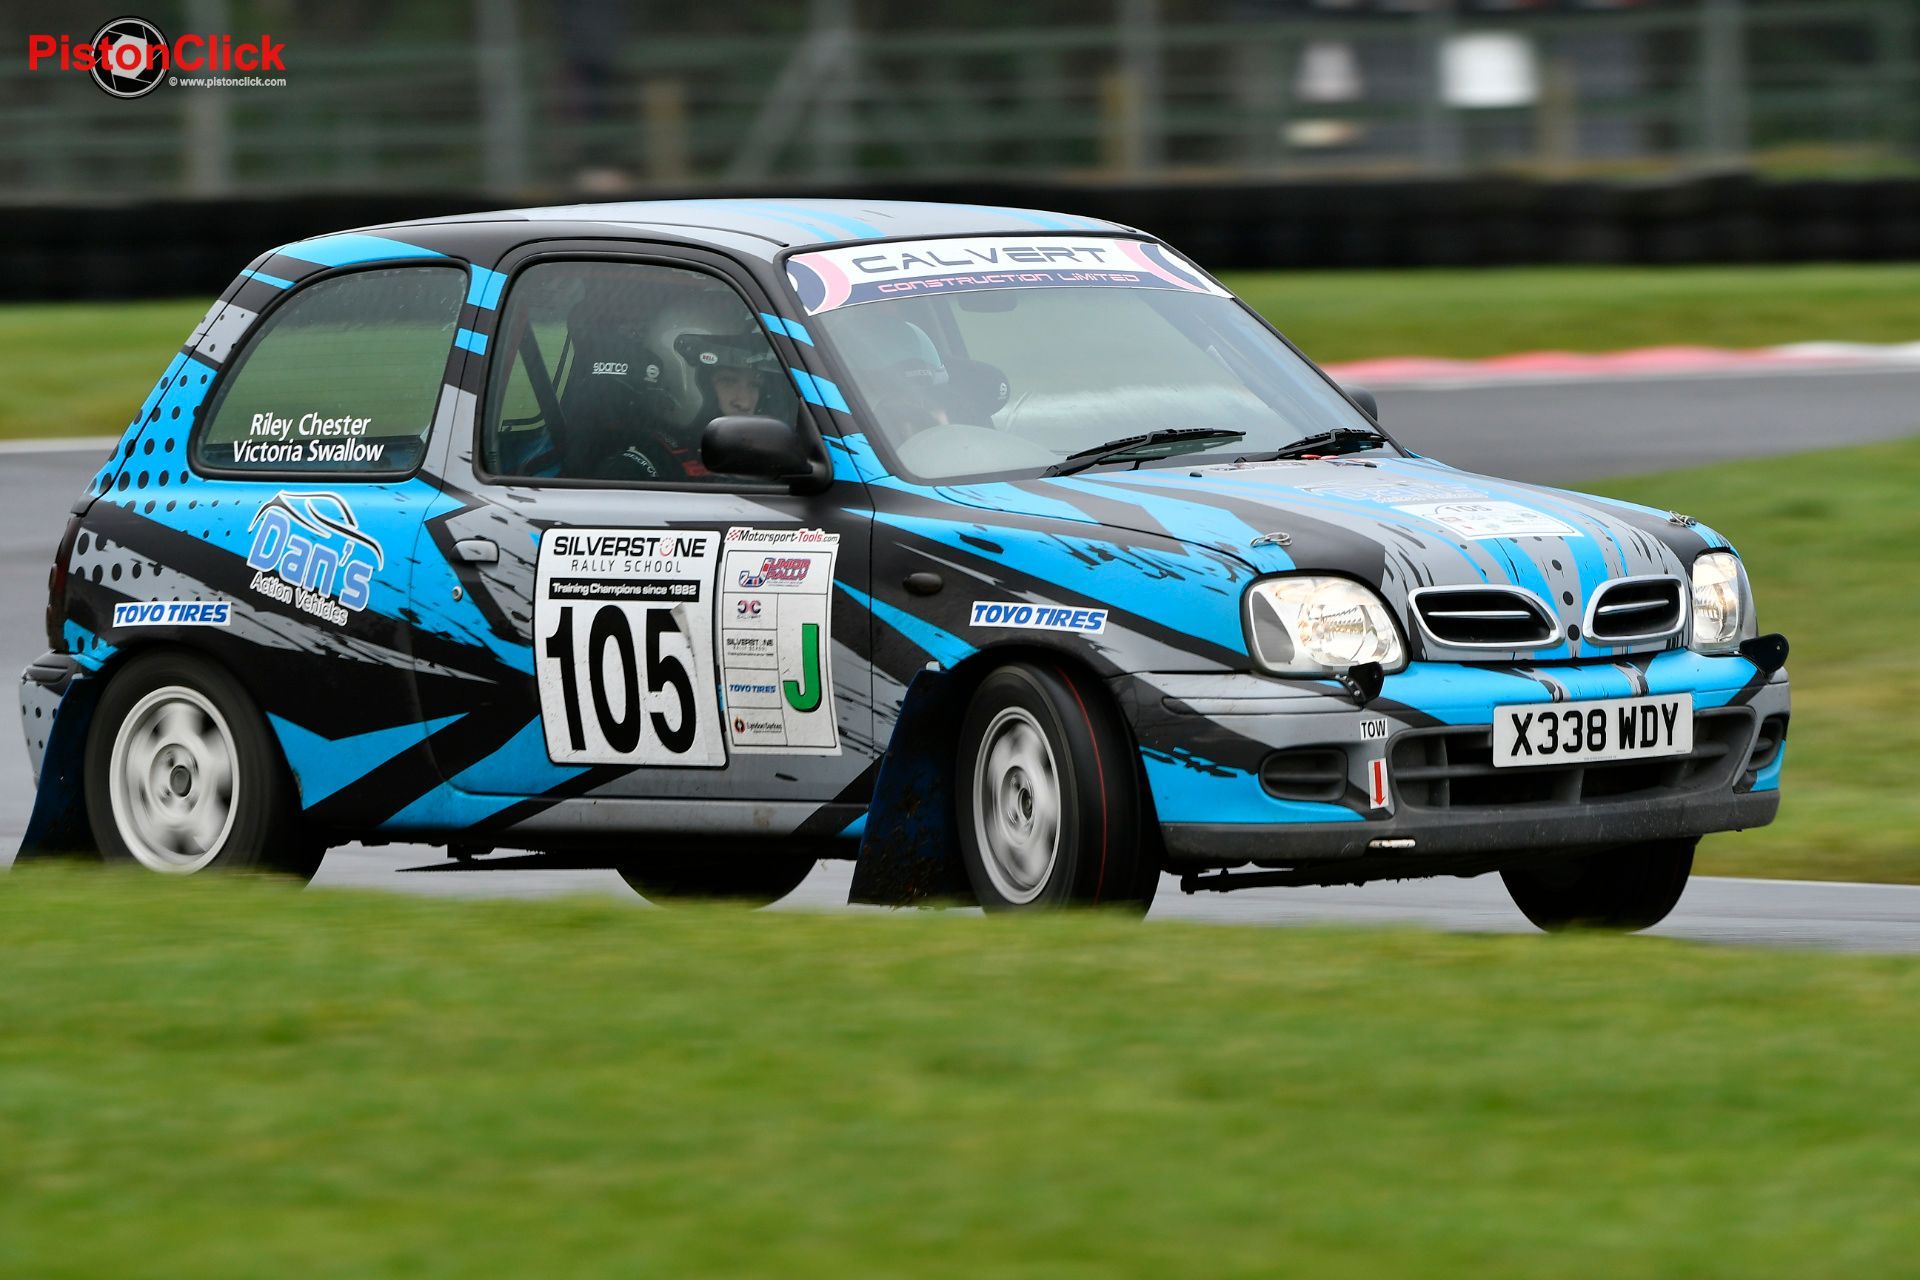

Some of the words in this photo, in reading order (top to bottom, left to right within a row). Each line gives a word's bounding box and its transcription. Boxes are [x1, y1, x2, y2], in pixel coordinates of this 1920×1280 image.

[852, 246, 1106, 273] CALVERT
[593, 362, 629, 375] sparco
[250, 412, 293, 438] Riley
[298, 411, 371, 436] Chester
[233, 439, 302, 462] Victoria
[307, 439, 384, 462] Swallow
[246, 509, 374, 612] Dan's
[571, 559, 615, 572] RALLY
[624, 560, 682, 573] SCHOOL
[250, 571, 294, 604] Action
[295, 588, 349, 626] Vehicles
[552, 582, 589, 596] Training
[590, 582, 641, 596] Champions
[642, 583, 667, 595] since
[116, 605, 167, 624] TOYO
[168, 604, 229, 623] TIRES
[973, 604, 1032, 625] TOYO
[1035, 607, 1106, 630] TIRES
[546, 604, 697, 753] 105
[782, 623, 823, 713] J
[729, 684, 751, 693] TOYO
[752, 685, 776, 694] TIRES
[1361, 720, 1387, 738] TOW
[1510, 712, 1607, 757] X338
[1618, 702, 1680, 750] WDY
